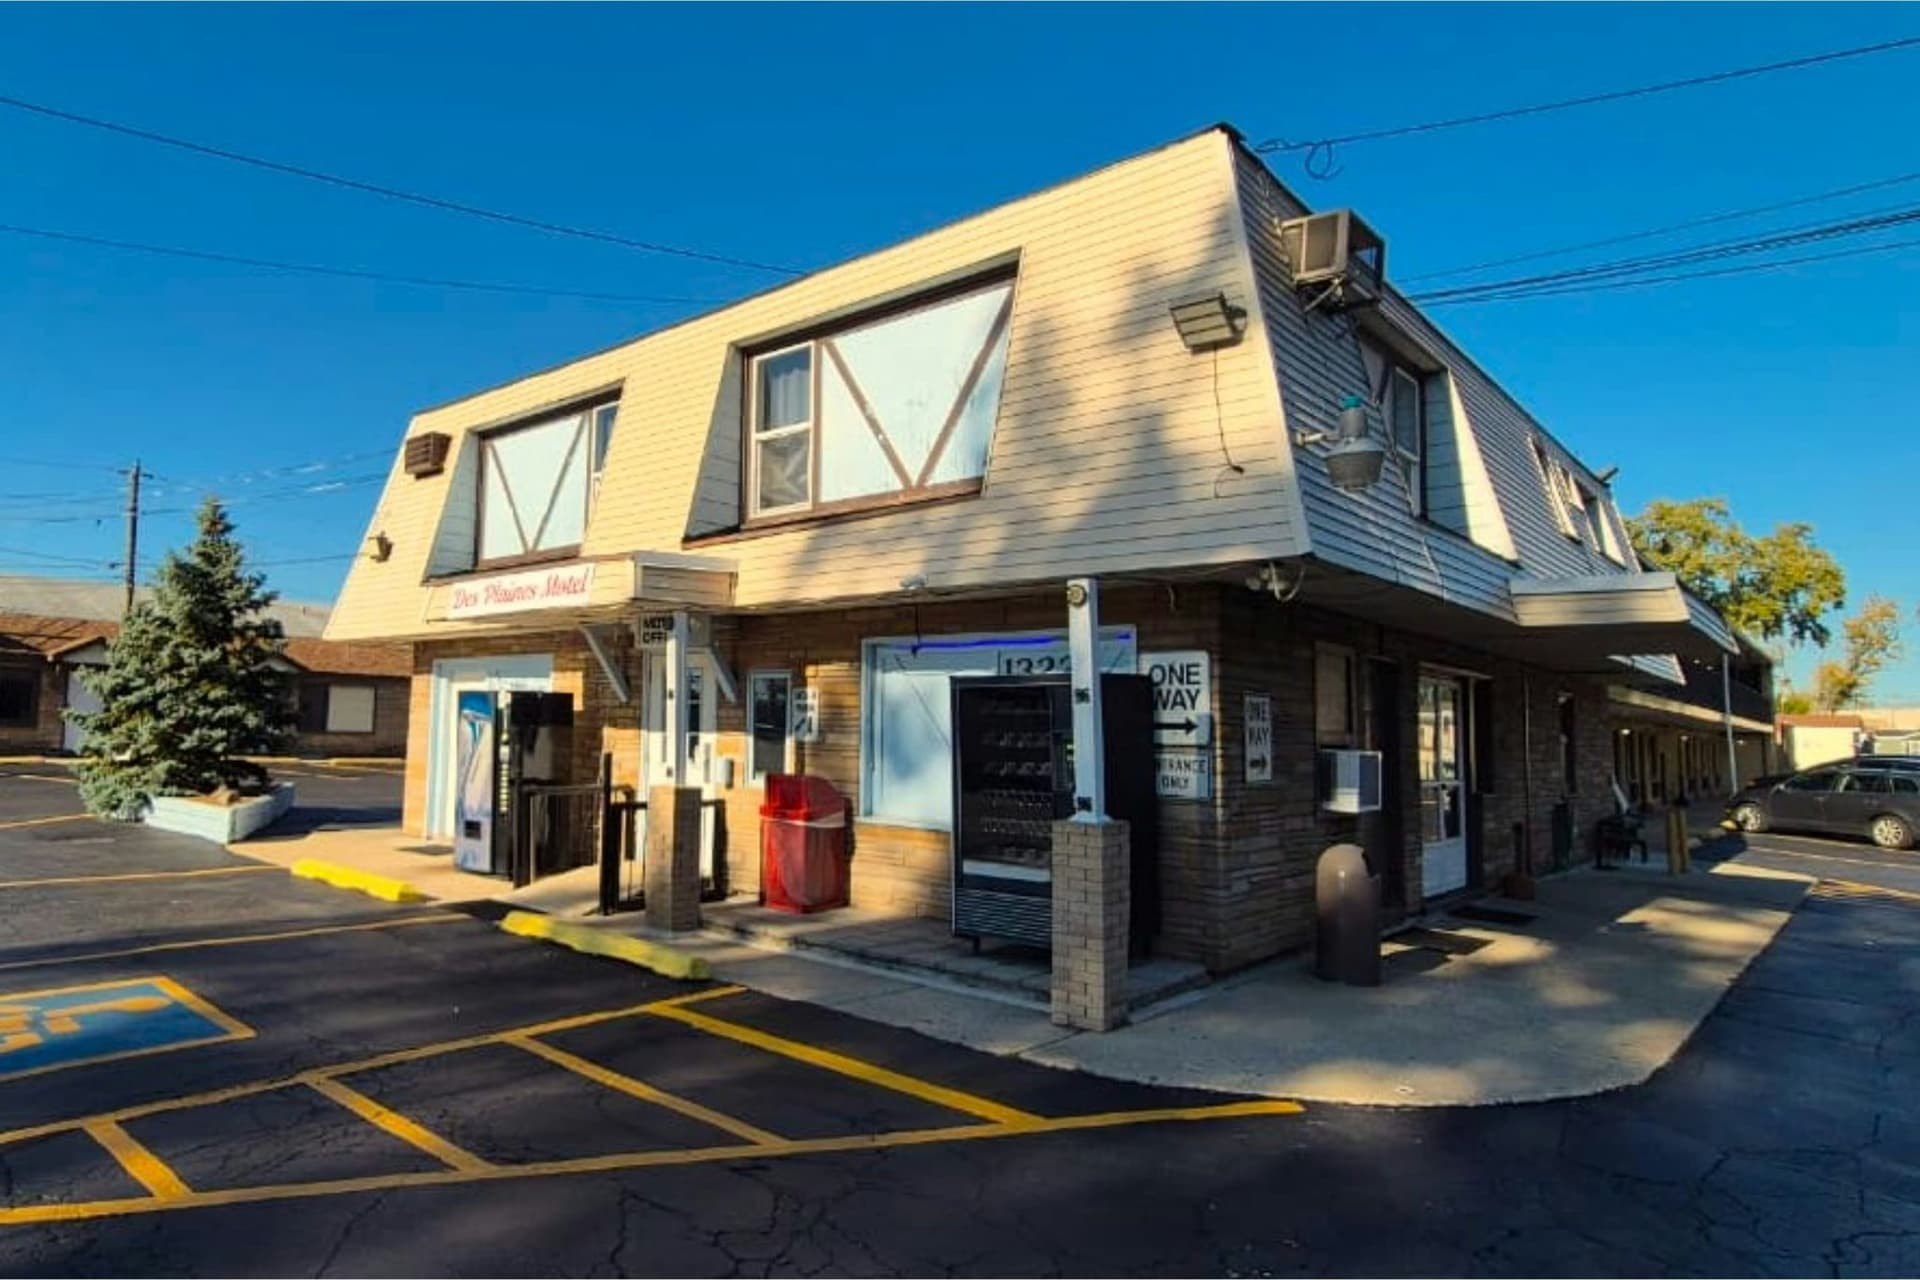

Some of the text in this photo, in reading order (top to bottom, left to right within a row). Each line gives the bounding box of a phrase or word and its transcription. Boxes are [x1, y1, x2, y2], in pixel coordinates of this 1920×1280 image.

[453, 566, 590, 608] Des Plaines Motel
[1149, 662, 1202, 687] ONE
[1153, 687, 1201, 711] WAY
[1161, 774, 1189, 789] ONLY
